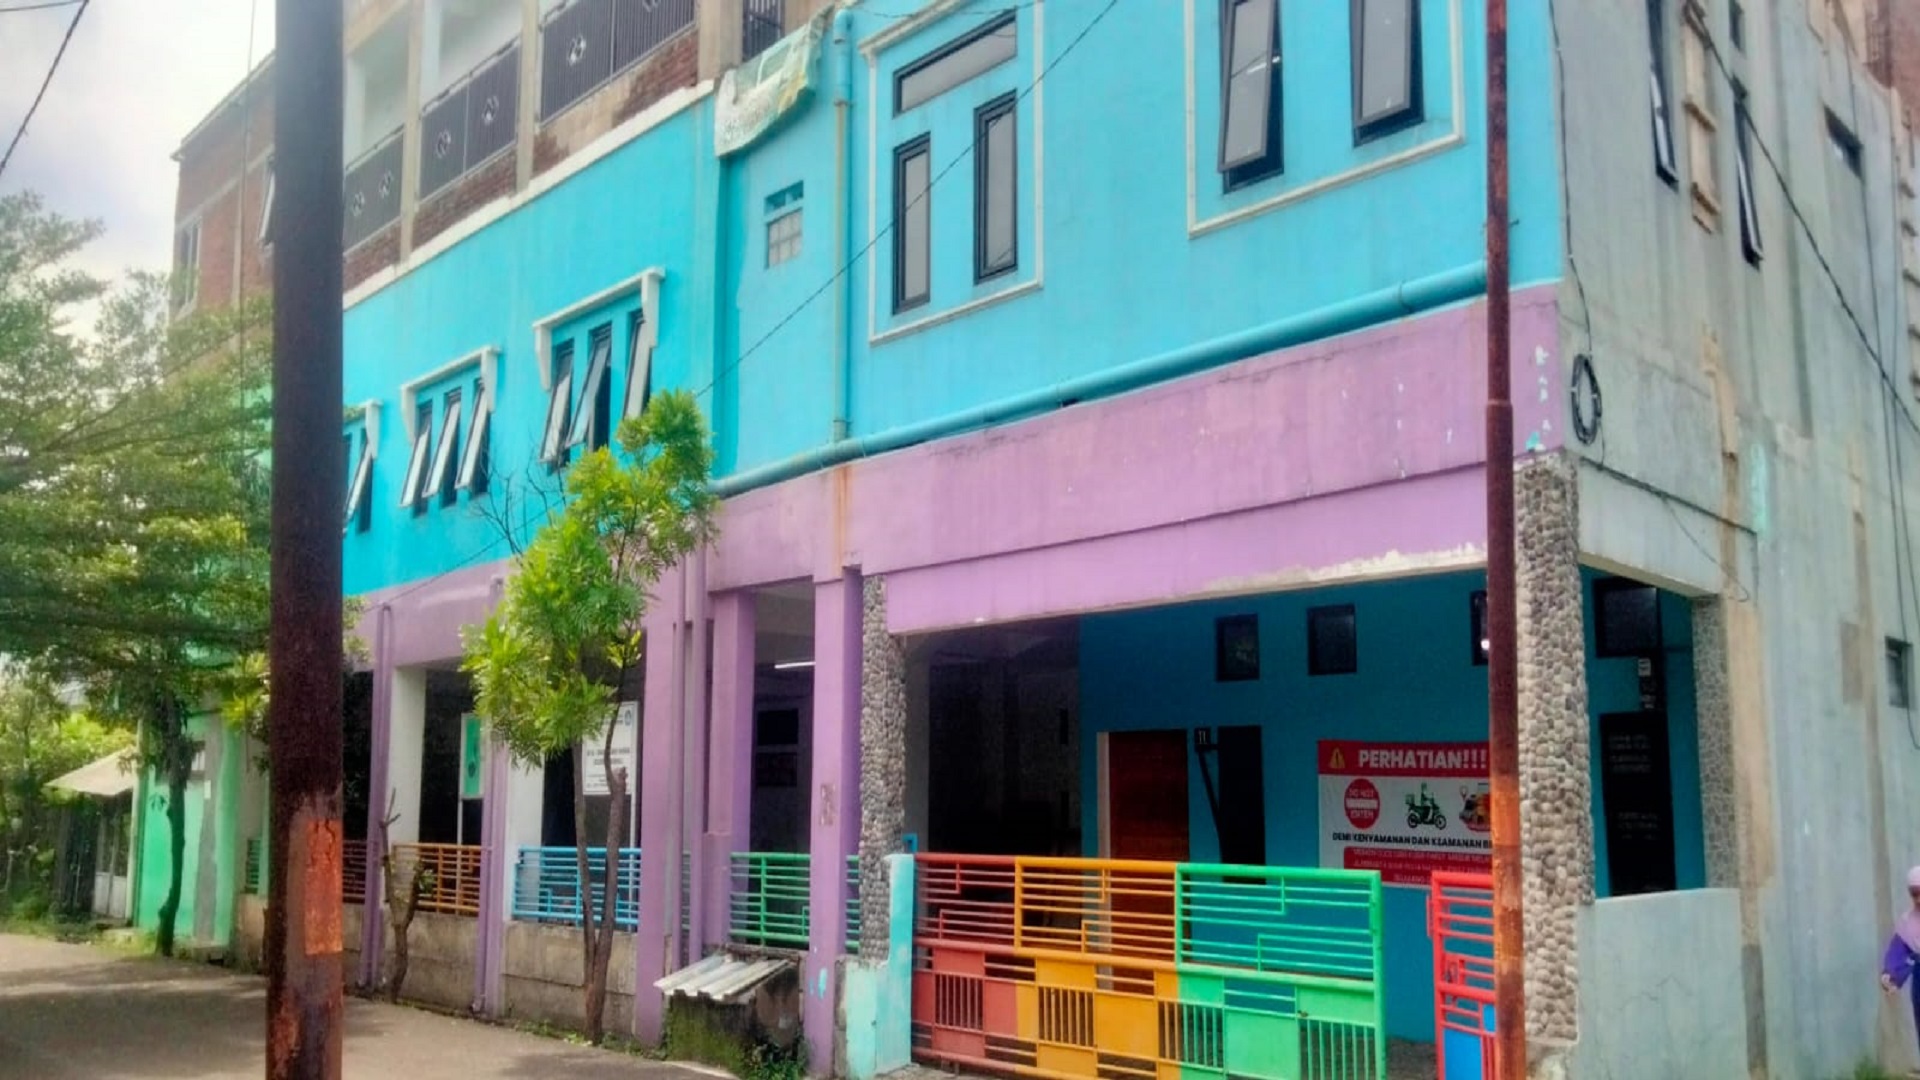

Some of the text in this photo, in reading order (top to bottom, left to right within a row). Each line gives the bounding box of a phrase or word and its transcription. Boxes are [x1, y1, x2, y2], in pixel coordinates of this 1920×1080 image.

[1358, 749, 1487, 768] PERHATIAN!!!
[1332, 832, 1351, 842] DEMI
[1353, 833, 1411, 845] KENYAMANAN
[1411, 836, 1430, 846] DAN
[1430, 837, 1482, 849] KEAMANAN
